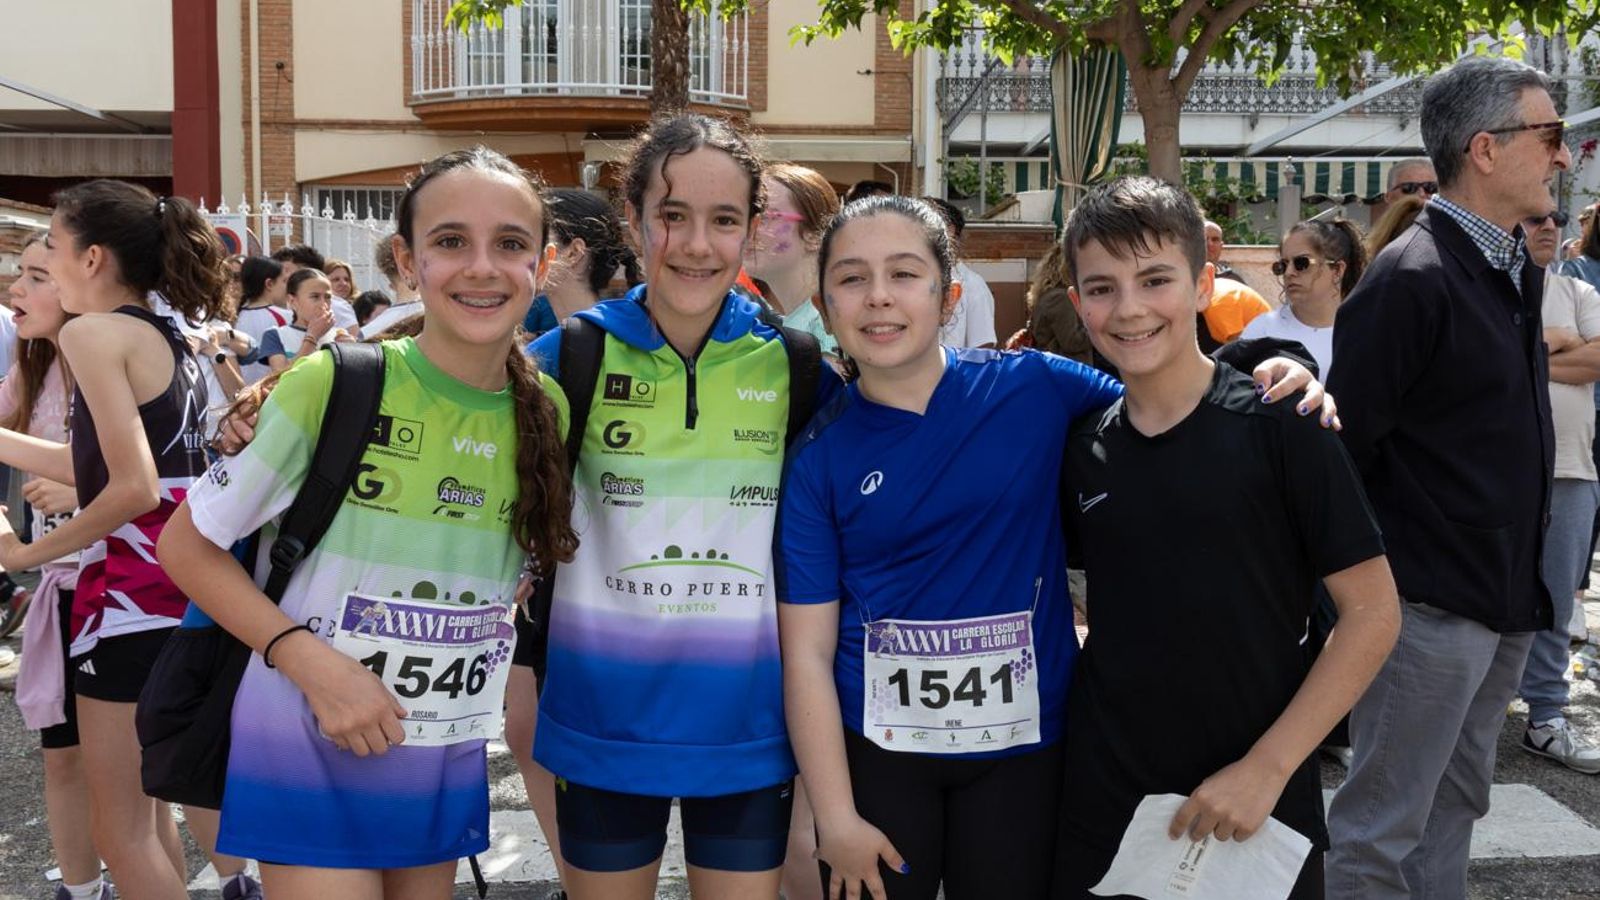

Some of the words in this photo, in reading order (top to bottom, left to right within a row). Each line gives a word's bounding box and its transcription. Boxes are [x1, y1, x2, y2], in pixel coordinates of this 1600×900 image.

[736, 387, 777, 403] vive
[452, 436, 497, 460] vive
[438, 487, 485, 507] ARIAS
[603, 482, 644, 496] ARIAS
[606, 575, 673, 597] CERRO
[658, 602, 717, 614] EVENTOS
[380, 608, 447, 640] XXXVI
[448, 614, 482, 628] CARRERA
[951, 625, 991, 641] CARRERA
[992, 619, 1025, 636] ESCOLAR
[453, 627, 467, 640] LA
[471, 622, 498, 639] GLORIA
[895, 627, 950, 653] XXXVI
[960, 639, 973, 651] LA
[981, 632, 1018, 649] GLORIA
[360, 650, 489, 700] 1546
[887, 663, 1014, 710] 1541
[411, 710, 438, 719] ROSARIO
[944, 719, 963, 727] IRENE
